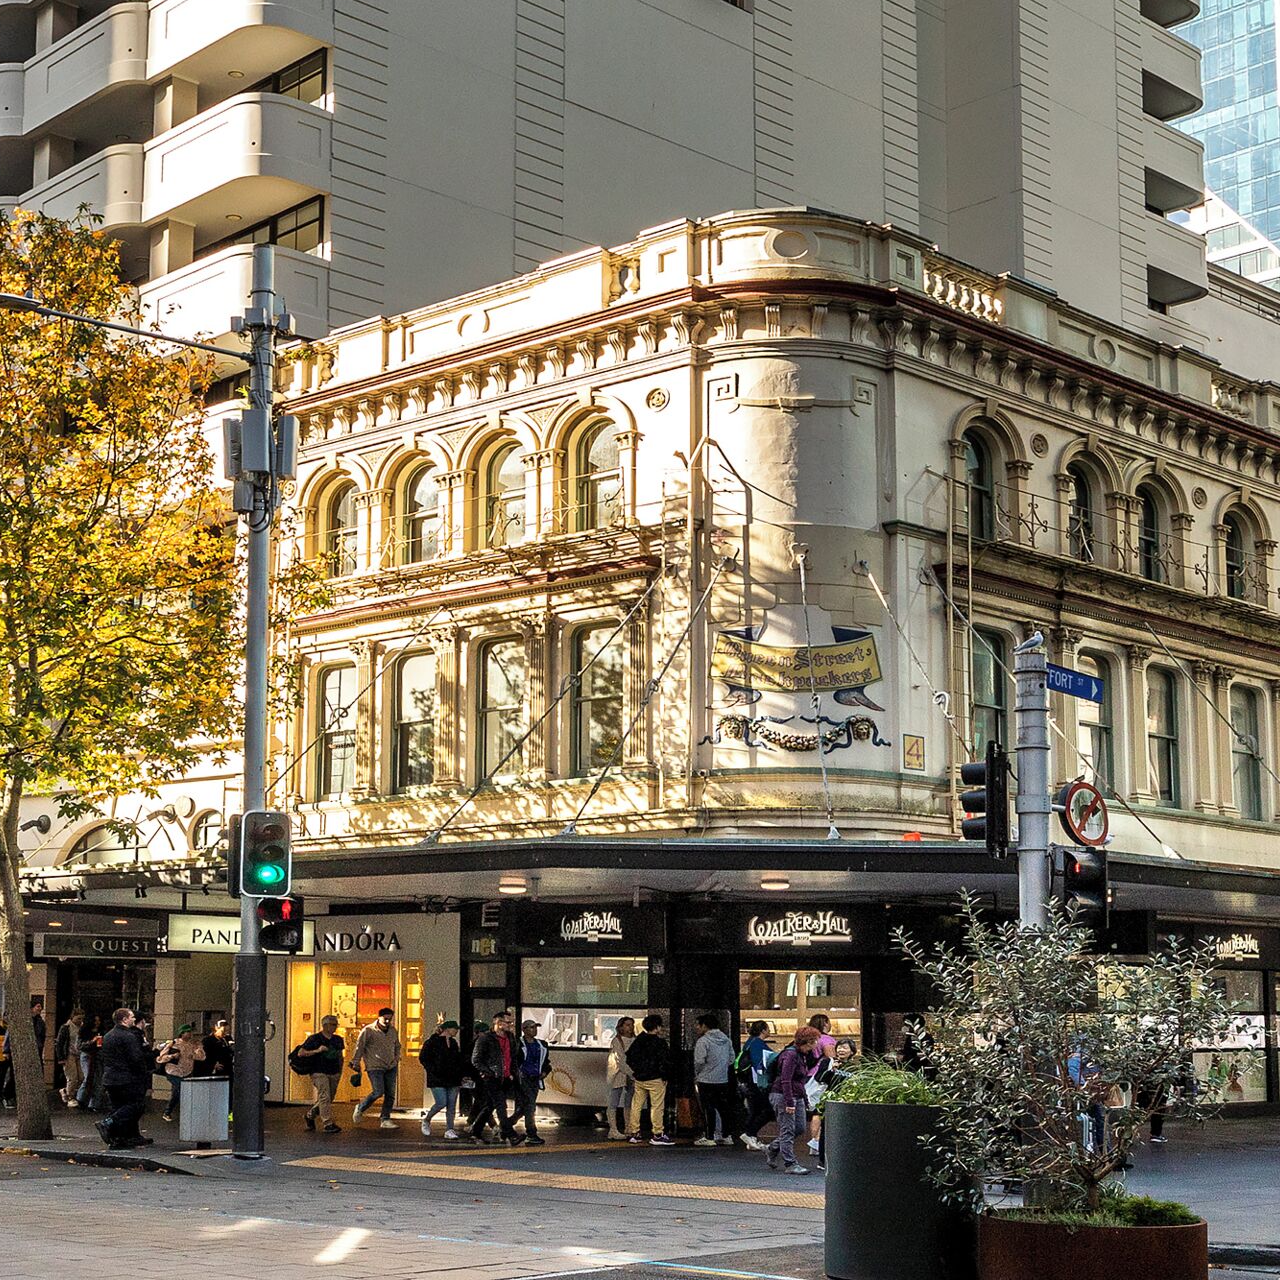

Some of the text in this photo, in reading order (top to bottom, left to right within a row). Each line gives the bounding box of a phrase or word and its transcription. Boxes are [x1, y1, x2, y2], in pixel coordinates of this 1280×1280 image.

[1049, 670, 1073, 690] FORT
[906, 739, 922, 760] 4
[92, 939, 151, 953] QUEST
[192, 928, 242, 946] PAND
[314, 924, 402, 952] ANDORA
